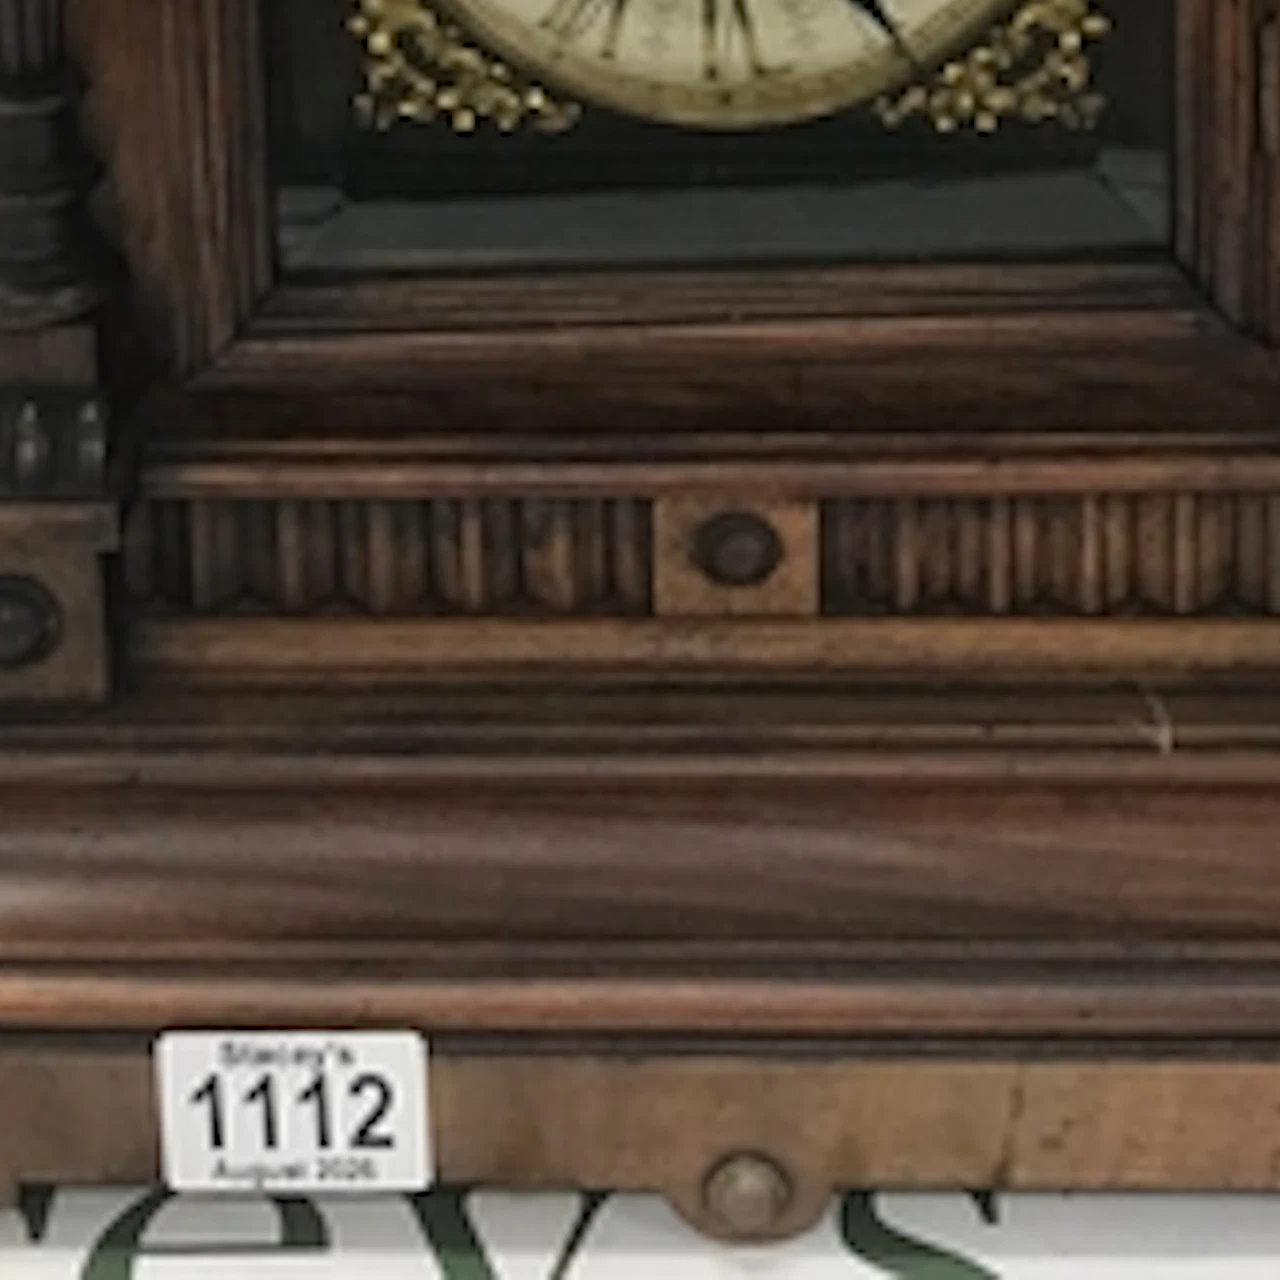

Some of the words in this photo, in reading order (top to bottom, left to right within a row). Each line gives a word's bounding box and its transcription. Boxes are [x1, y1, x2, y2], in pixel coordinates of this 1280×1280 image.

[220, 1042, 355, 1076] Stacey's
[188, 1071, 396, 1150] 1112
[210, 1157, 308, 1190] August
